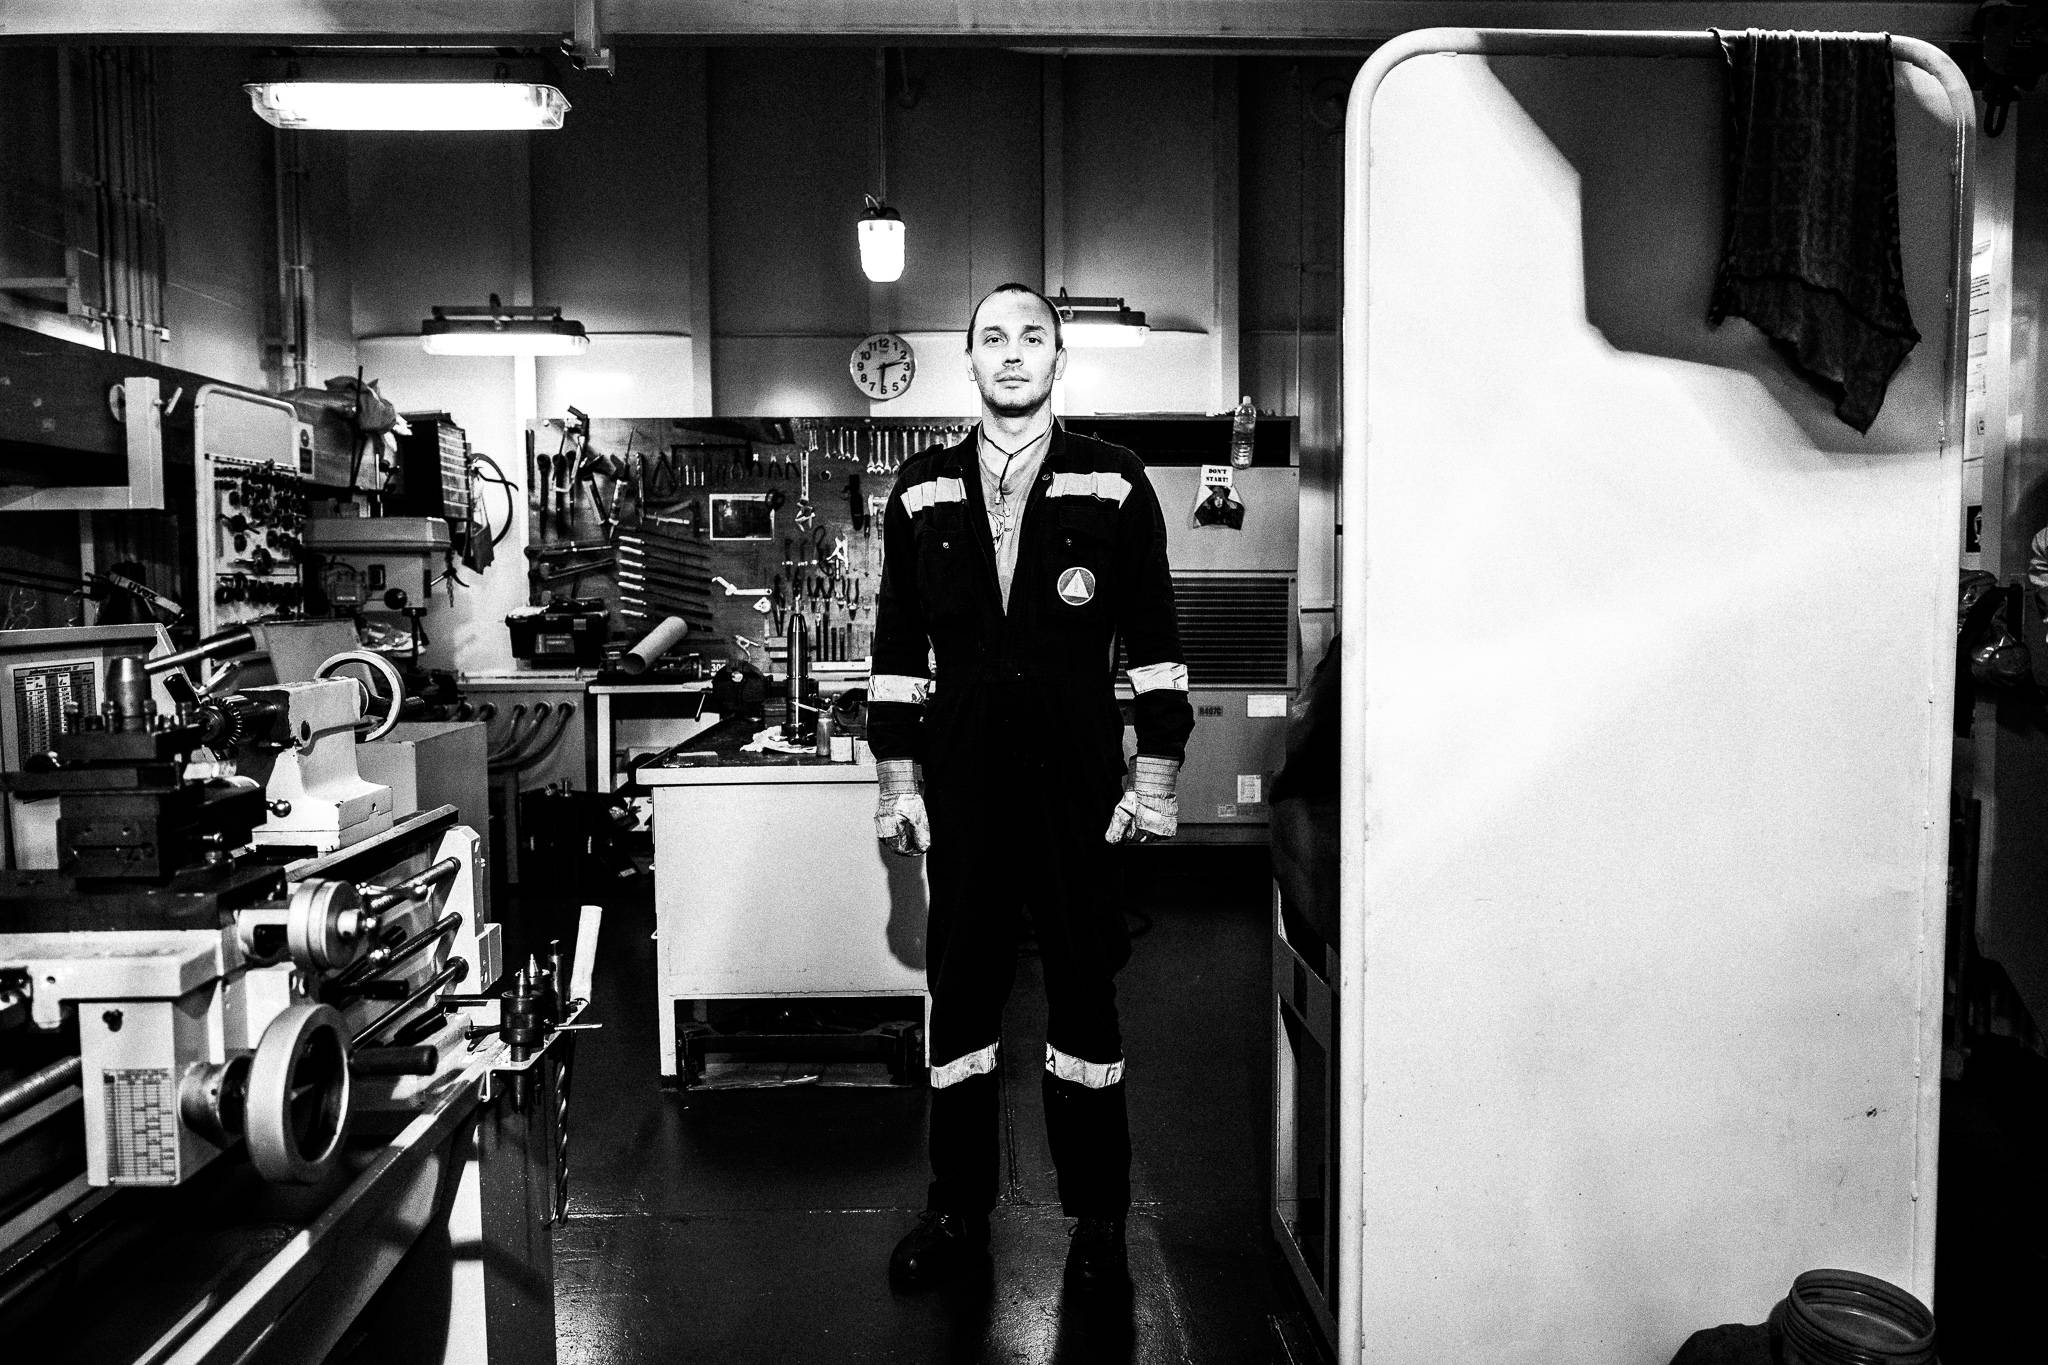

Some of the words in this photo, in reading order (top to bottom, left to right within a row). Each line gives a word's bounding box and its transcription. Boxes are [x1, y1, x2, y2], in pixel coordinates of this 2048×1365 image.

[868, 342, 877, 351] 11
[879, 338, 889, 348] 12
[893, 342, 898, 351] 1
[860, 351, 871, 360] 10
[900, 350, 907, 360] 2
[857, 362, 864, 371] 9
[903, 362, 910, 371] 3
[861, 373, 867, 383] 8
[900, 374, 907, 383] 4
[869, 382, 876, 391] 7
[881, 385, 887, 394] 6
[892, 382, 899, 391] 5
